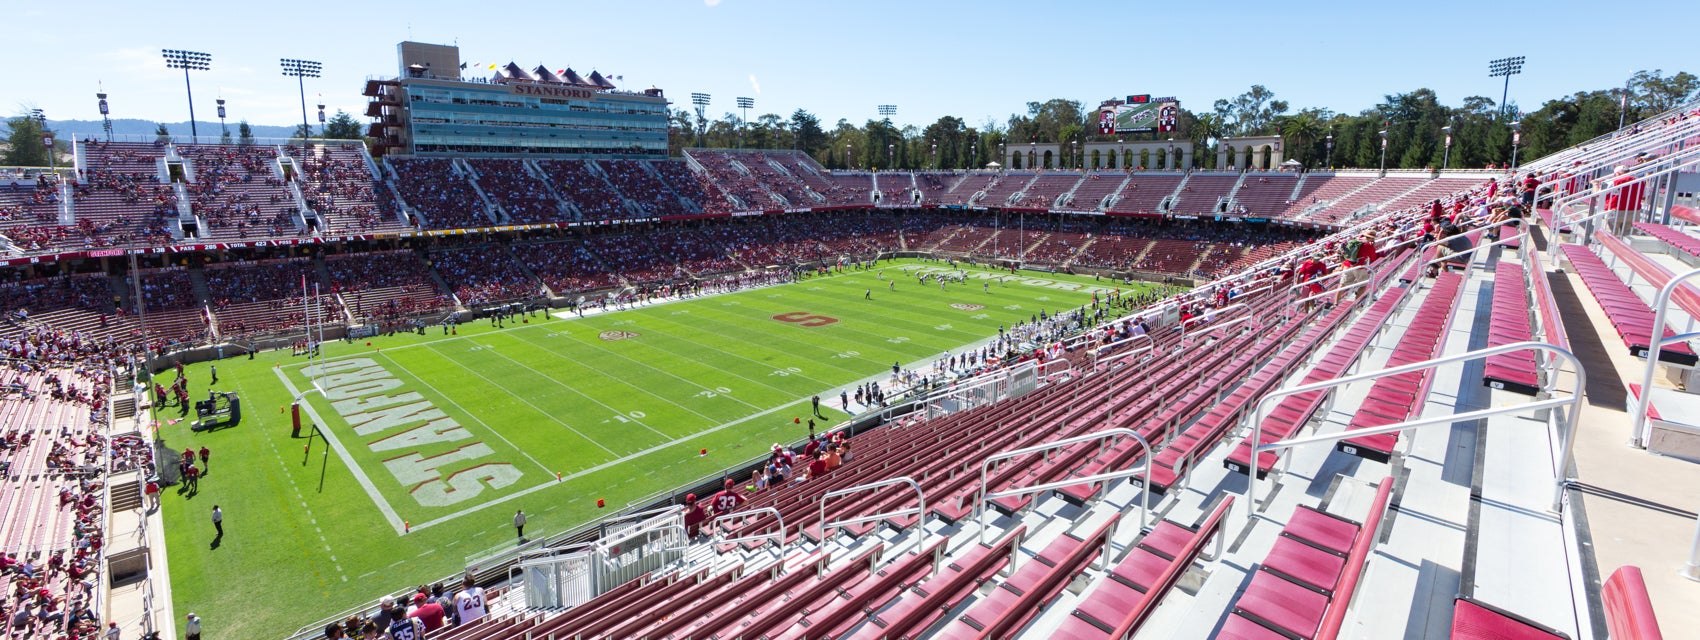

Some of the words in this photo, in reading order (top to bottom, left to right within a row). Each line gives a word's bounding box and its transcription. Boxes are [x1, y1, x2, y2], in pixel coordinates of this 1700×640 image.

[515, 85, 592, 99] STANFORD
[770, 311, 840, 327] S
[773, 367, 802, 377] 30
[700, 386, 732, 399] 20
[613, 410, 646, 424] 10
[300, 357, 524, 508] STANFORD
[718, 495, 736, 510] 33
[463, 594, 482, 611] 23
[394, 626, 415, 640] 35
